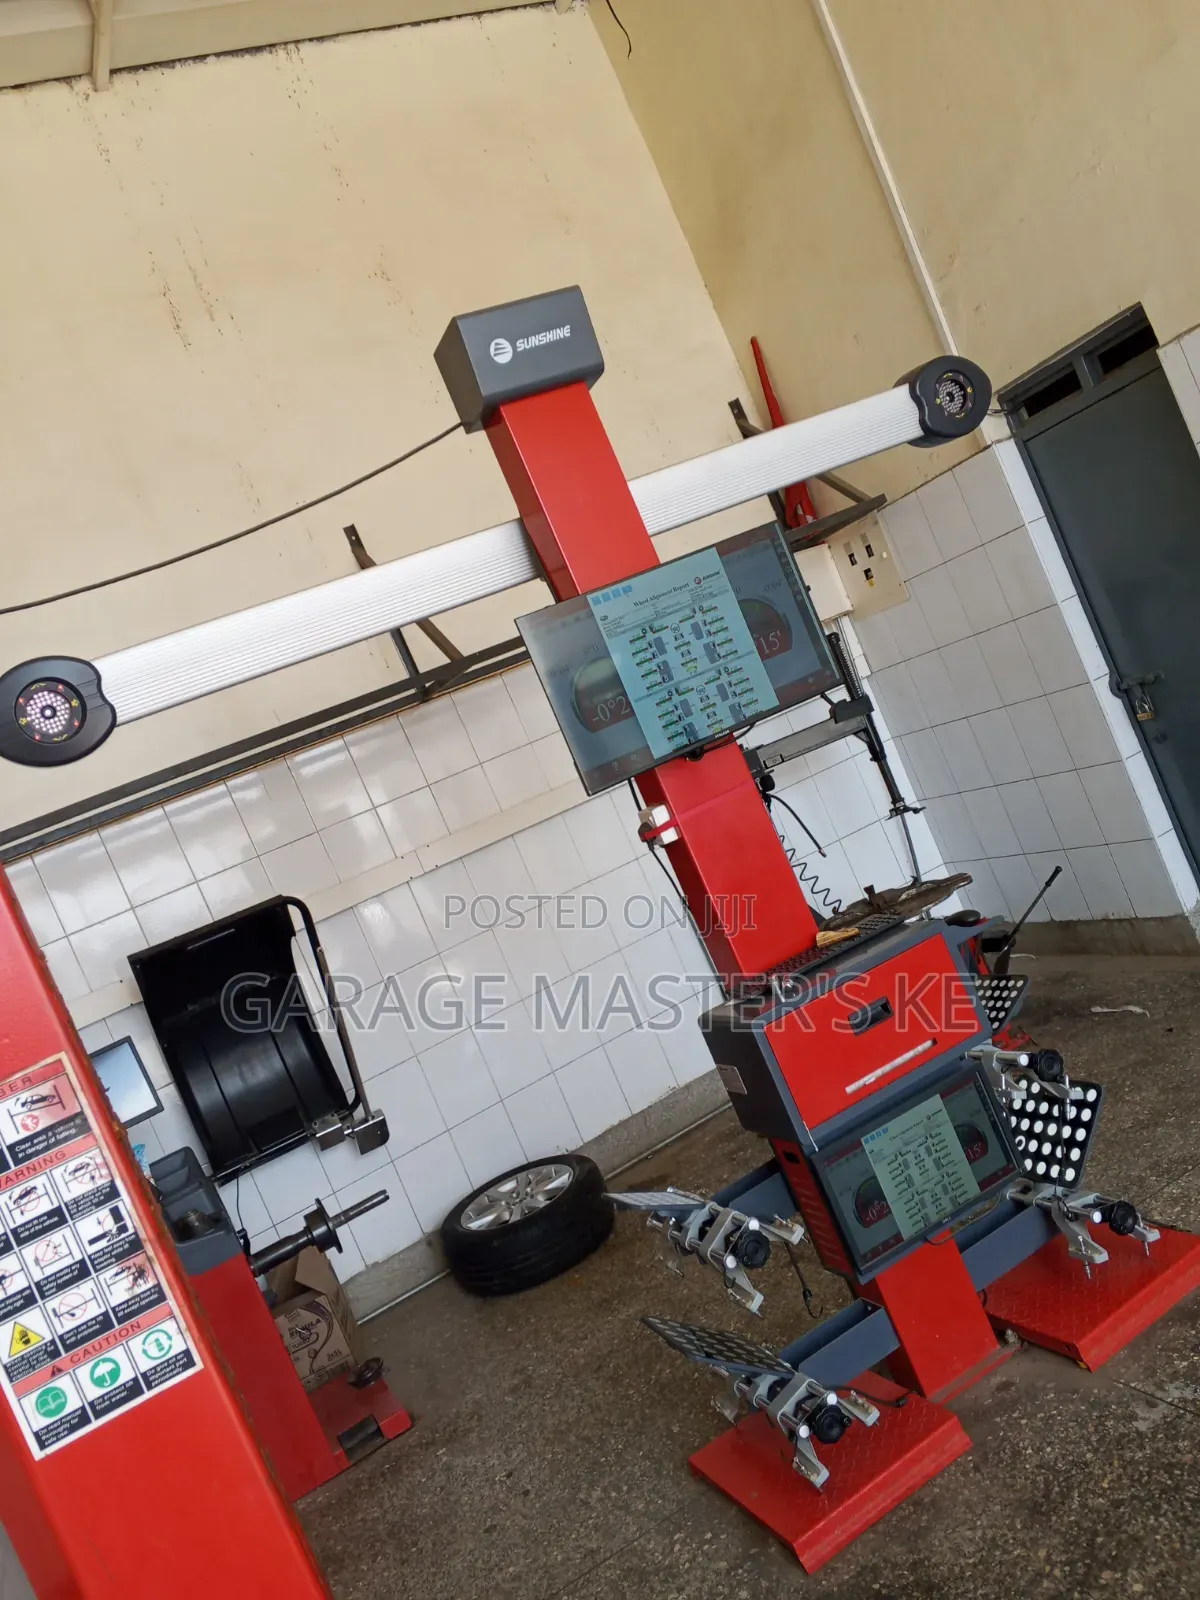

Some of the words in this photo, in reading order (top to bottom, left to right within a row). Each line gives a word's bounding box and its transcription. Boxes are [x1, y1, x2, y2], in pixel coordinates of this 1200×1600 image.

[516, 325, 571, 352] SUNSHINE
[15, 1141, 31, 1152] Clear
[115, 1303, 128, 1312] Keep
[70, 1321, 141, 1364] CAUTION
[149, 1364, 175, 1381] important
[104, 1385, 125, 1401] protect
[96, 1400, 110, 1410] from
[38, 1428, 47, 1436] Do
[48, 1421, 61, 1430] read
[41, 1423, 70, 1440] thoroughly
[45, 1437, 57, 1446] safe
